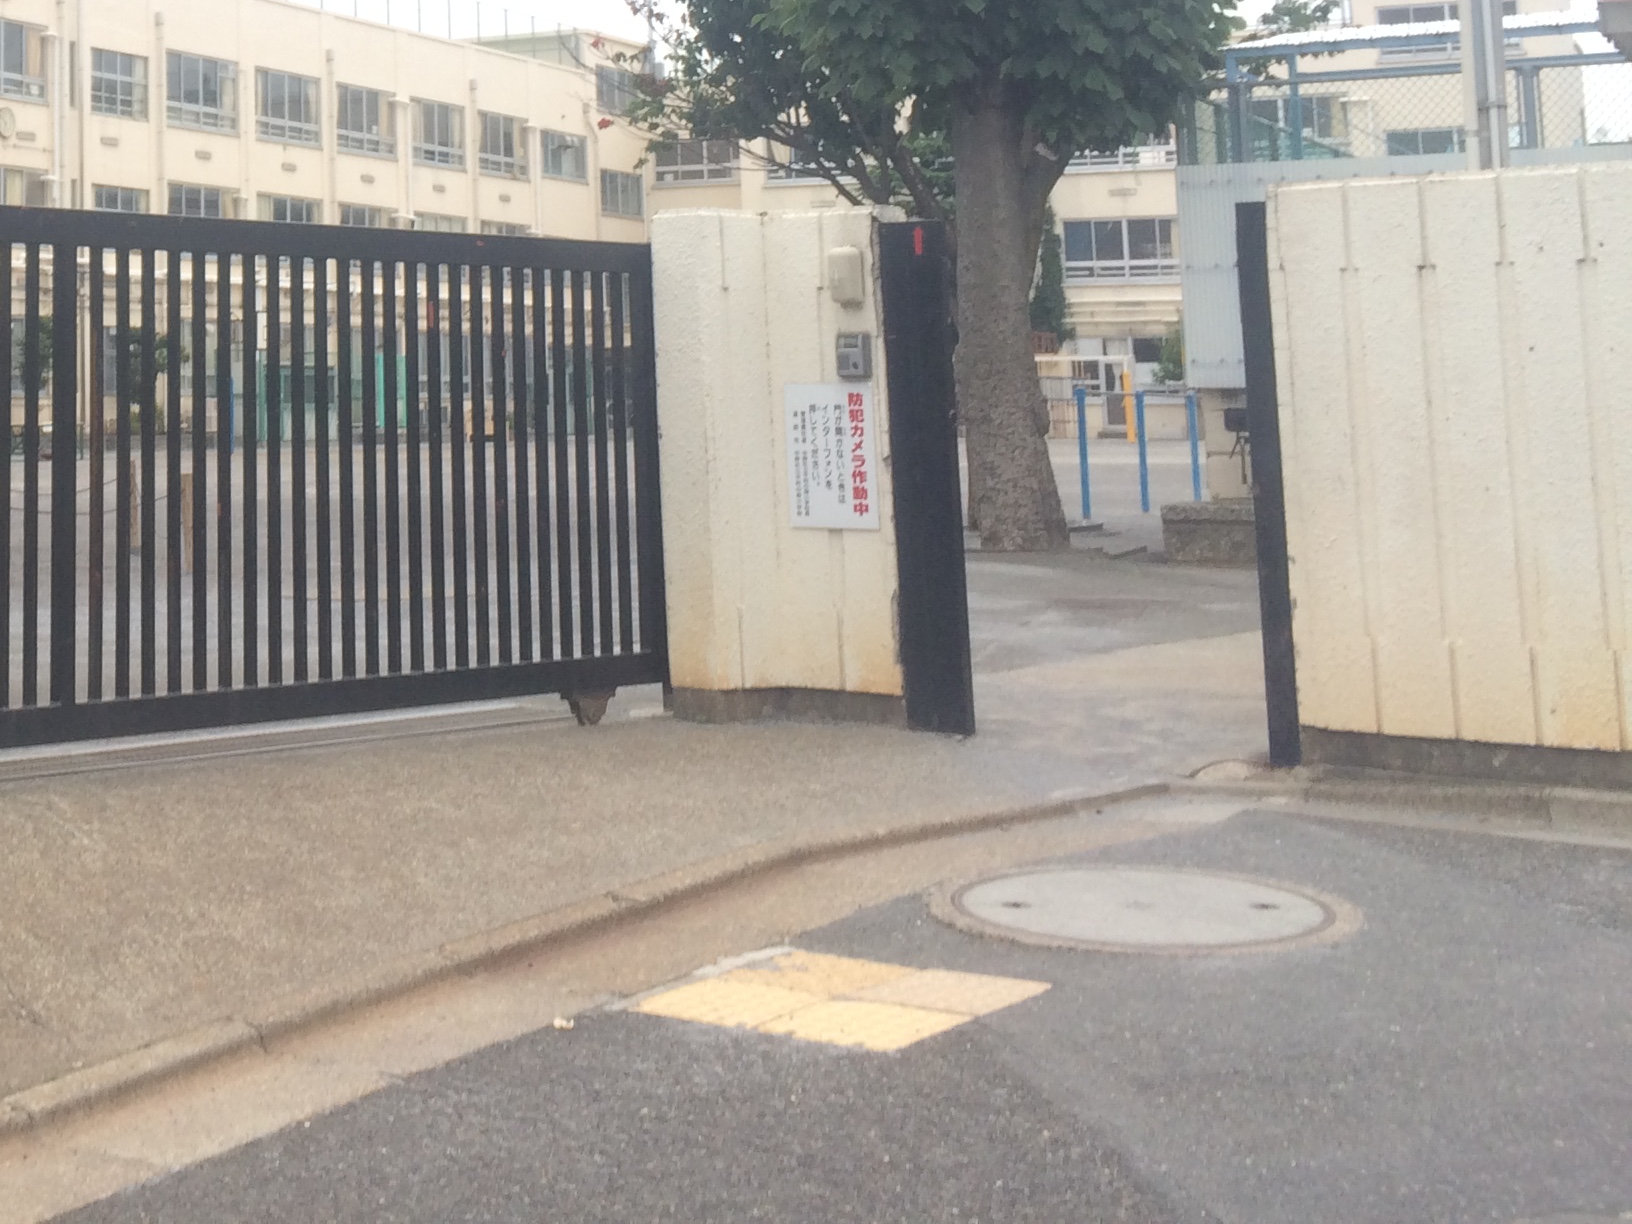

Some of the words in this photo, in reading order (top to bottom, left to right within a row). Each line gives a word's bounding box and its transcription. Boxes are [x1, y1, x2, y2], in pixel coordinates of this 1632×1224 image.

[847, 392, 869, 516] 防犯カメラ作動中
